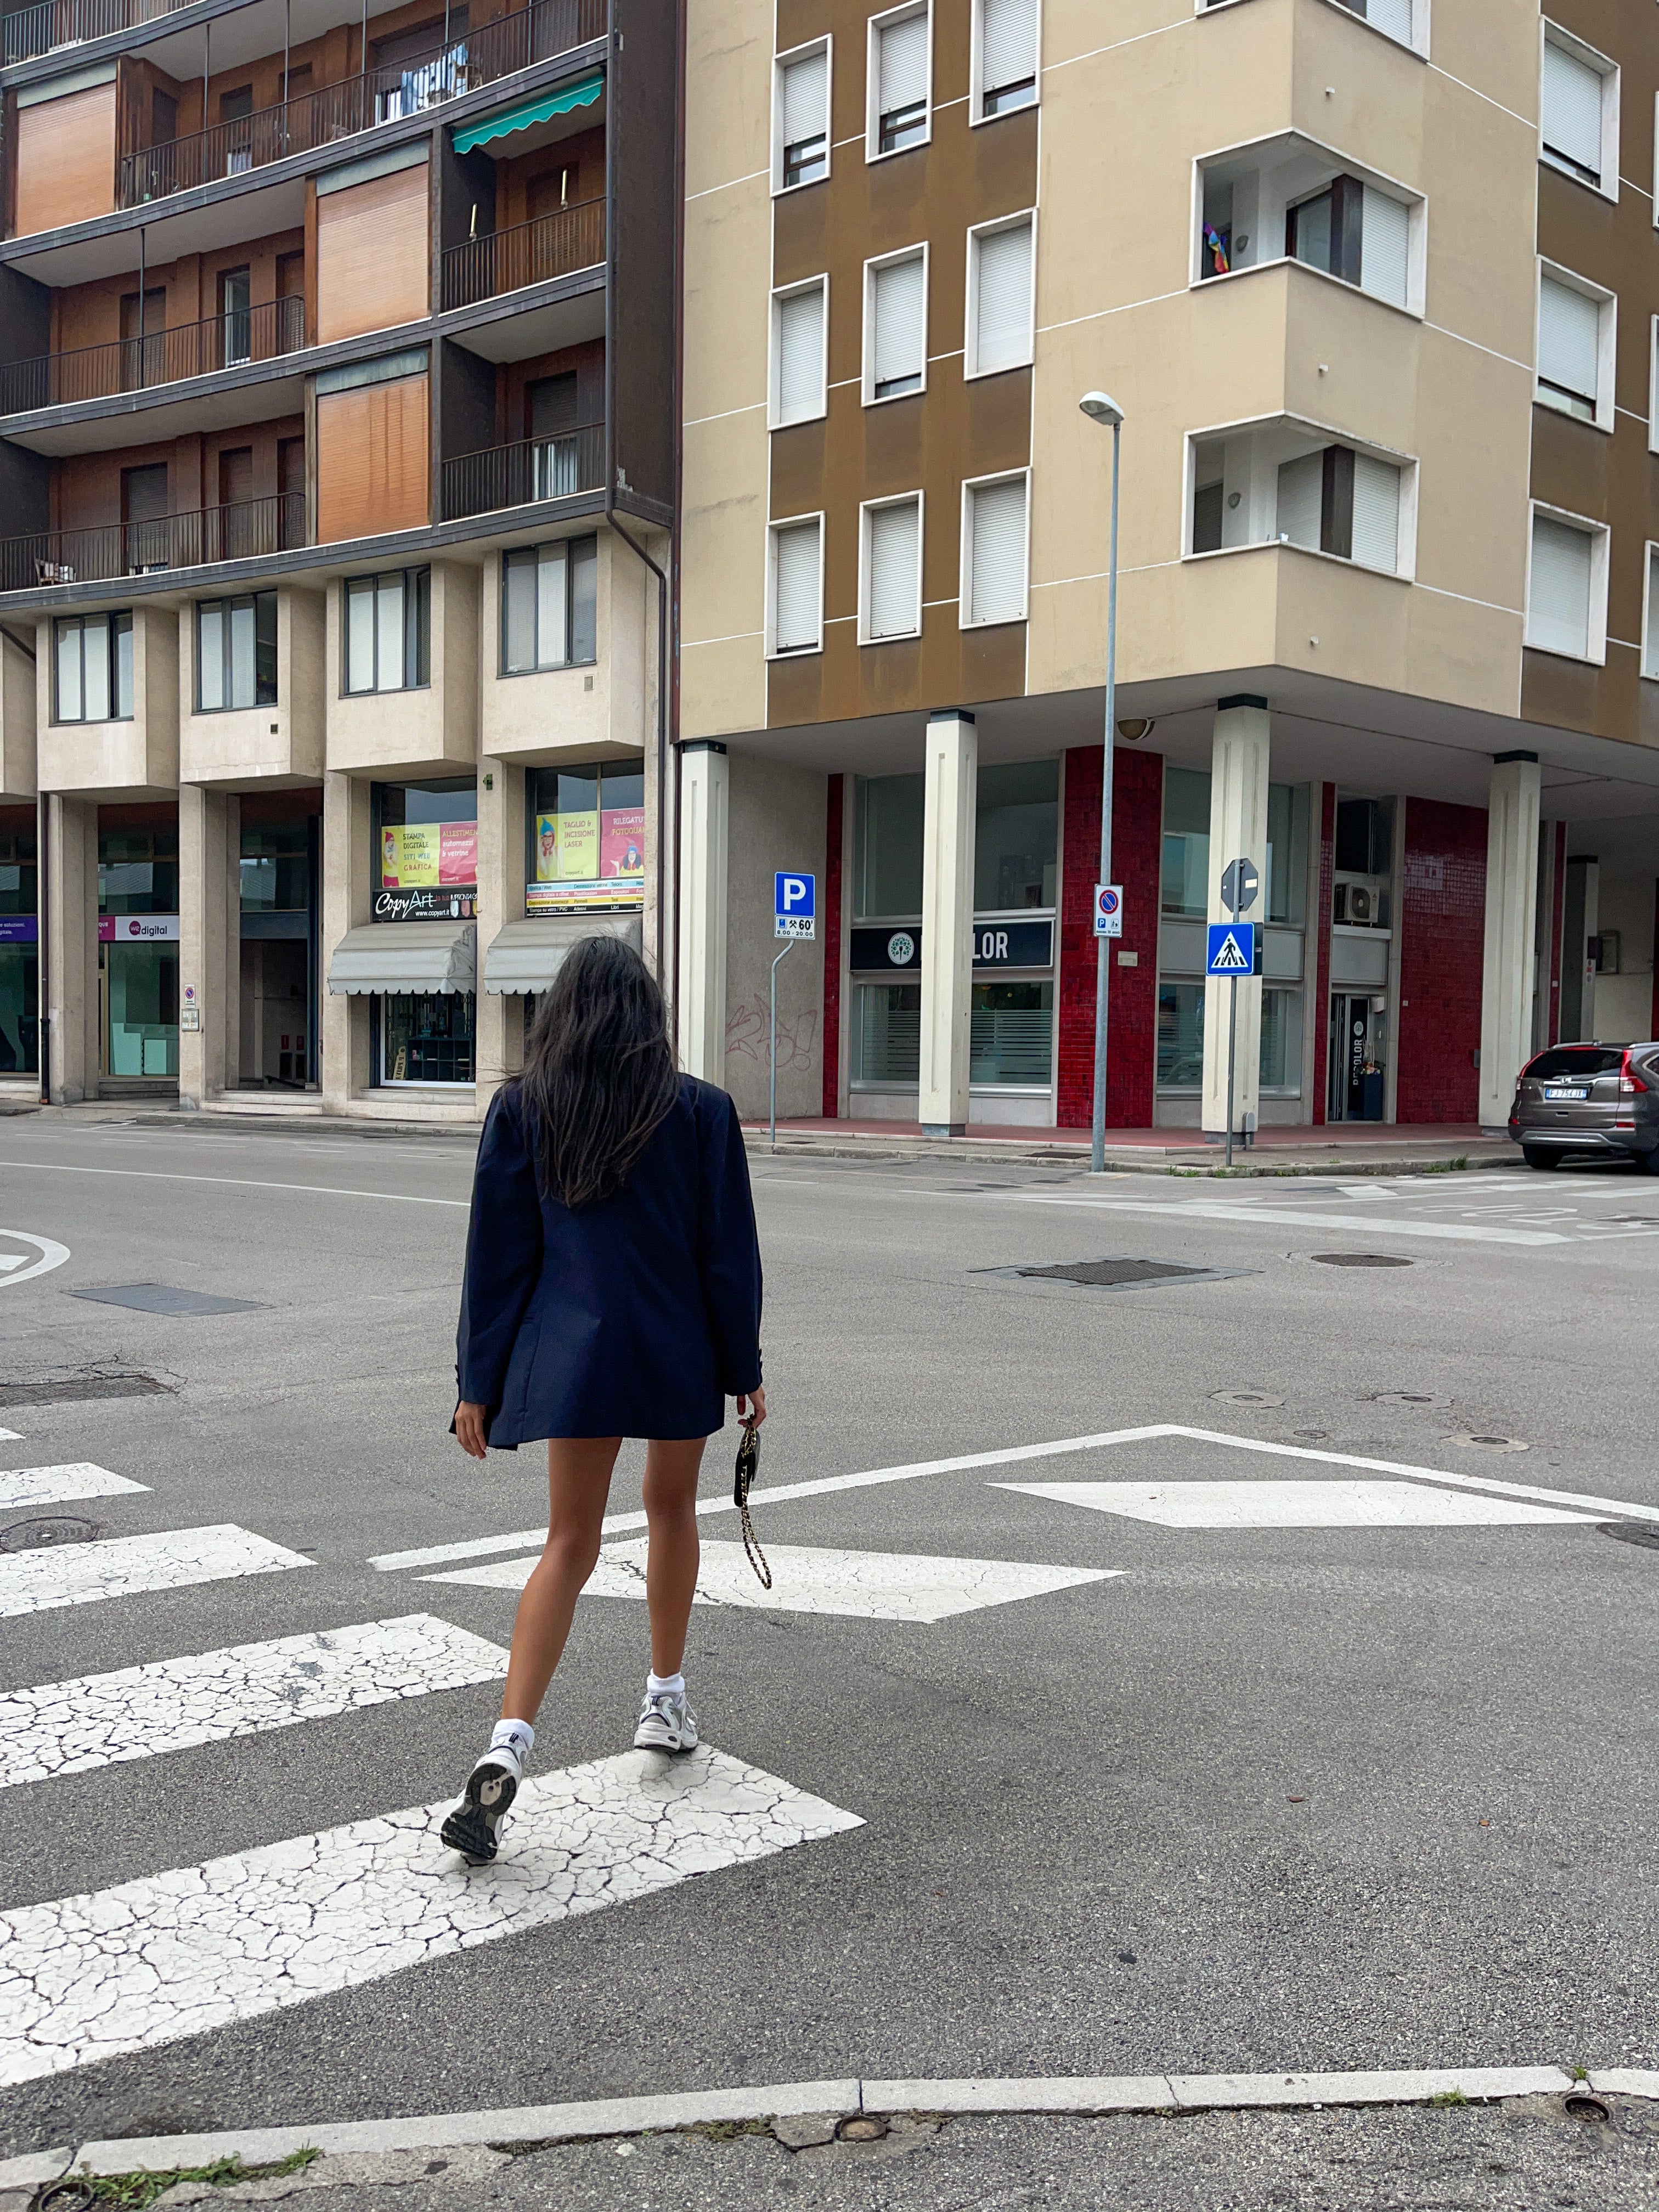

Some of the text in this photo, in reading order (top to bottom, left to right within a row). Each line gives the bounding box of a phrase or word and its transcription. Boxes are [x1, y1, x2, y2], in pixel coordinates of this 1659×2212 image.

[564, 830, 595, 838] INCISIONE
[612, 827, 644, 836] FOTOQUA
[783, 878, 806, 910] P
[141, 926, 167, 936] digital
